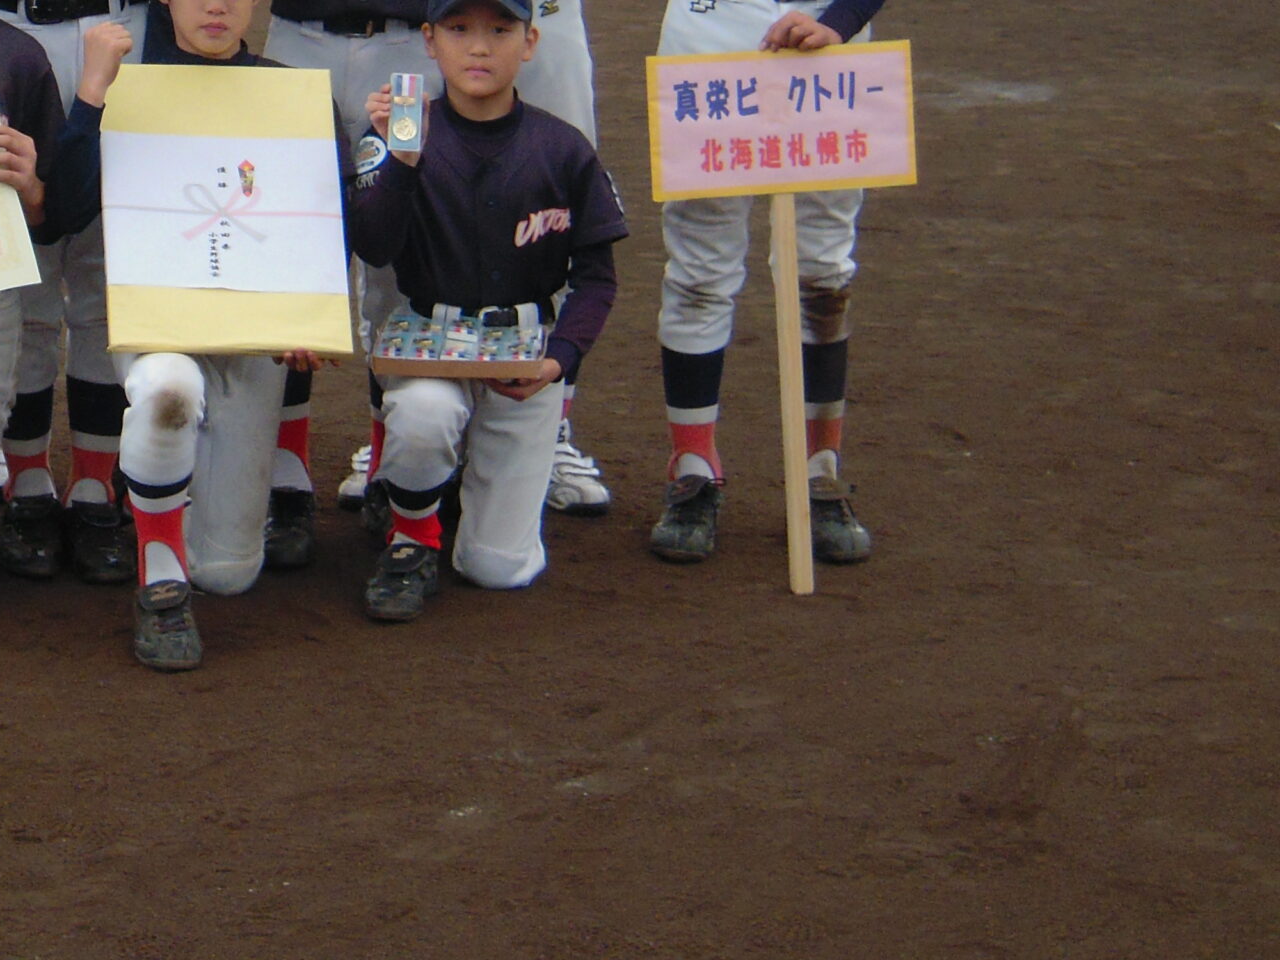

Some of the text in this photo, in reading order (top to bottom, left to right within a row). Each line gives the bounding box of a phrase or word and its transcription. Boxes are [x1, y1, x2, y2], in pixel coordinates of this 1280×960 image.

[700, 129, 868, 173] 北海道札幌市
